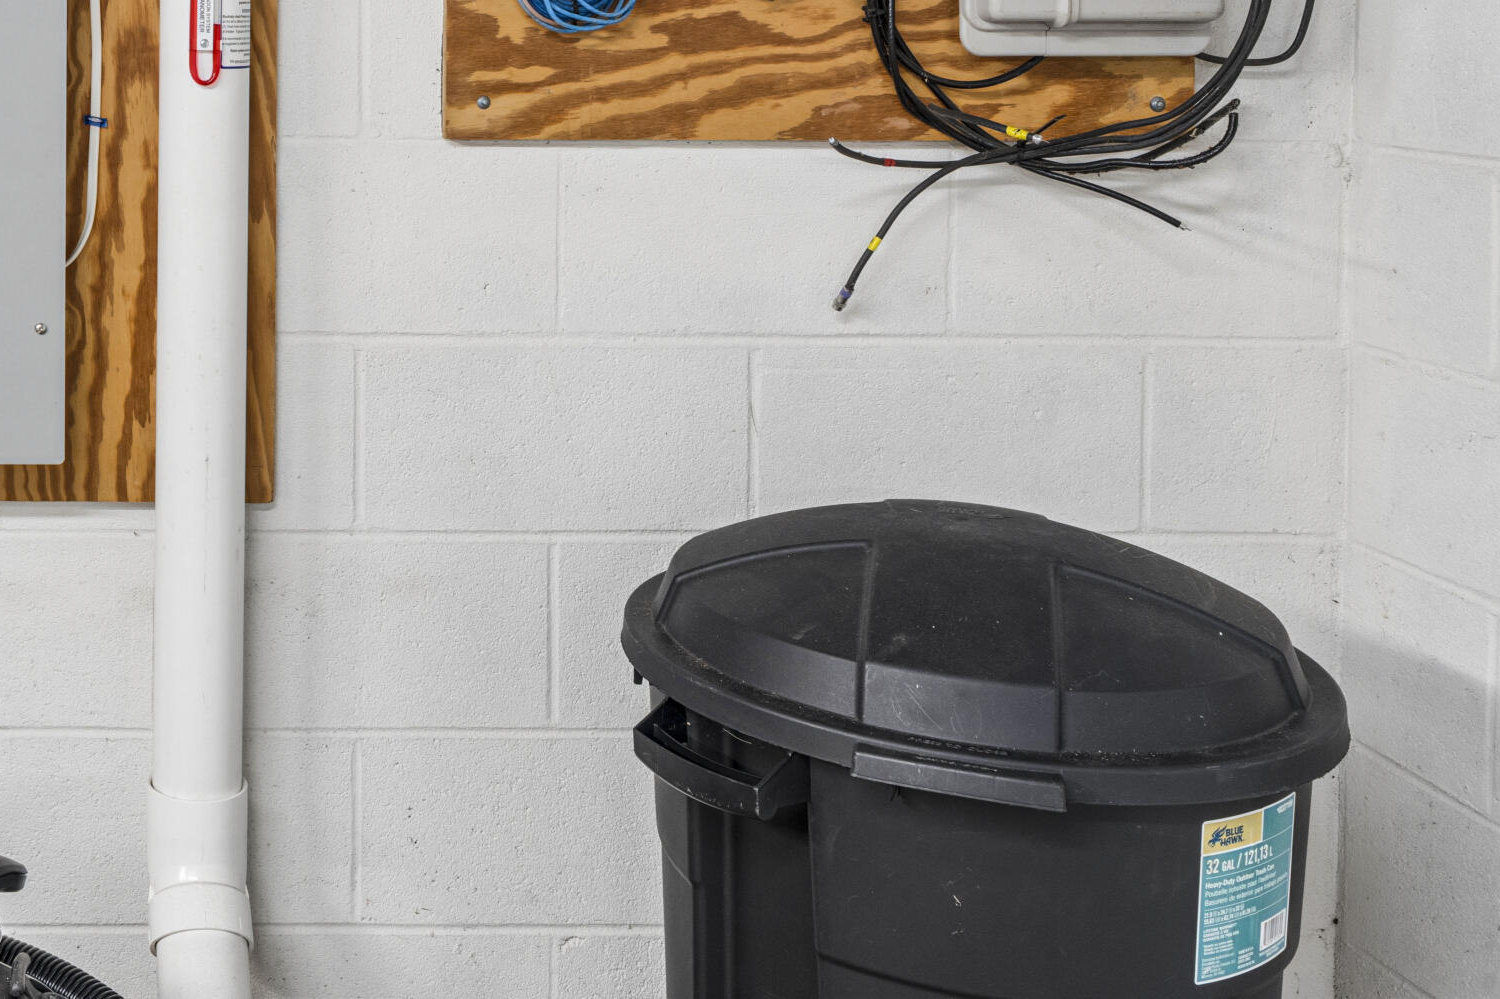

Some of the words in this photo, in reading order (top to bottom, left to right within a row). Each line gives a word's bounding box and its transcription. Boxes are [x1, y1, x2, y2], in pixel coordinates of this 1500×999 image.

[1225, 825, 1244, 837] BLUE
[1220, 835, 1243, 847] HAWK
[1206, 858, 1220, 875] 32
[1222, 859, 1236, 872] GAL
[1237, 853, 1243, 869] /
[1244, 844, 1269, 866] 121,13
[1270, 846, 1274, 857] L
[1206, 878, 1235, 890] Heavy-Duty
[1236, 873, 1255, 883] Outdoor
[1255, 868, 1267, 877] Trash
[1267, 864, 1275, 872] Can
